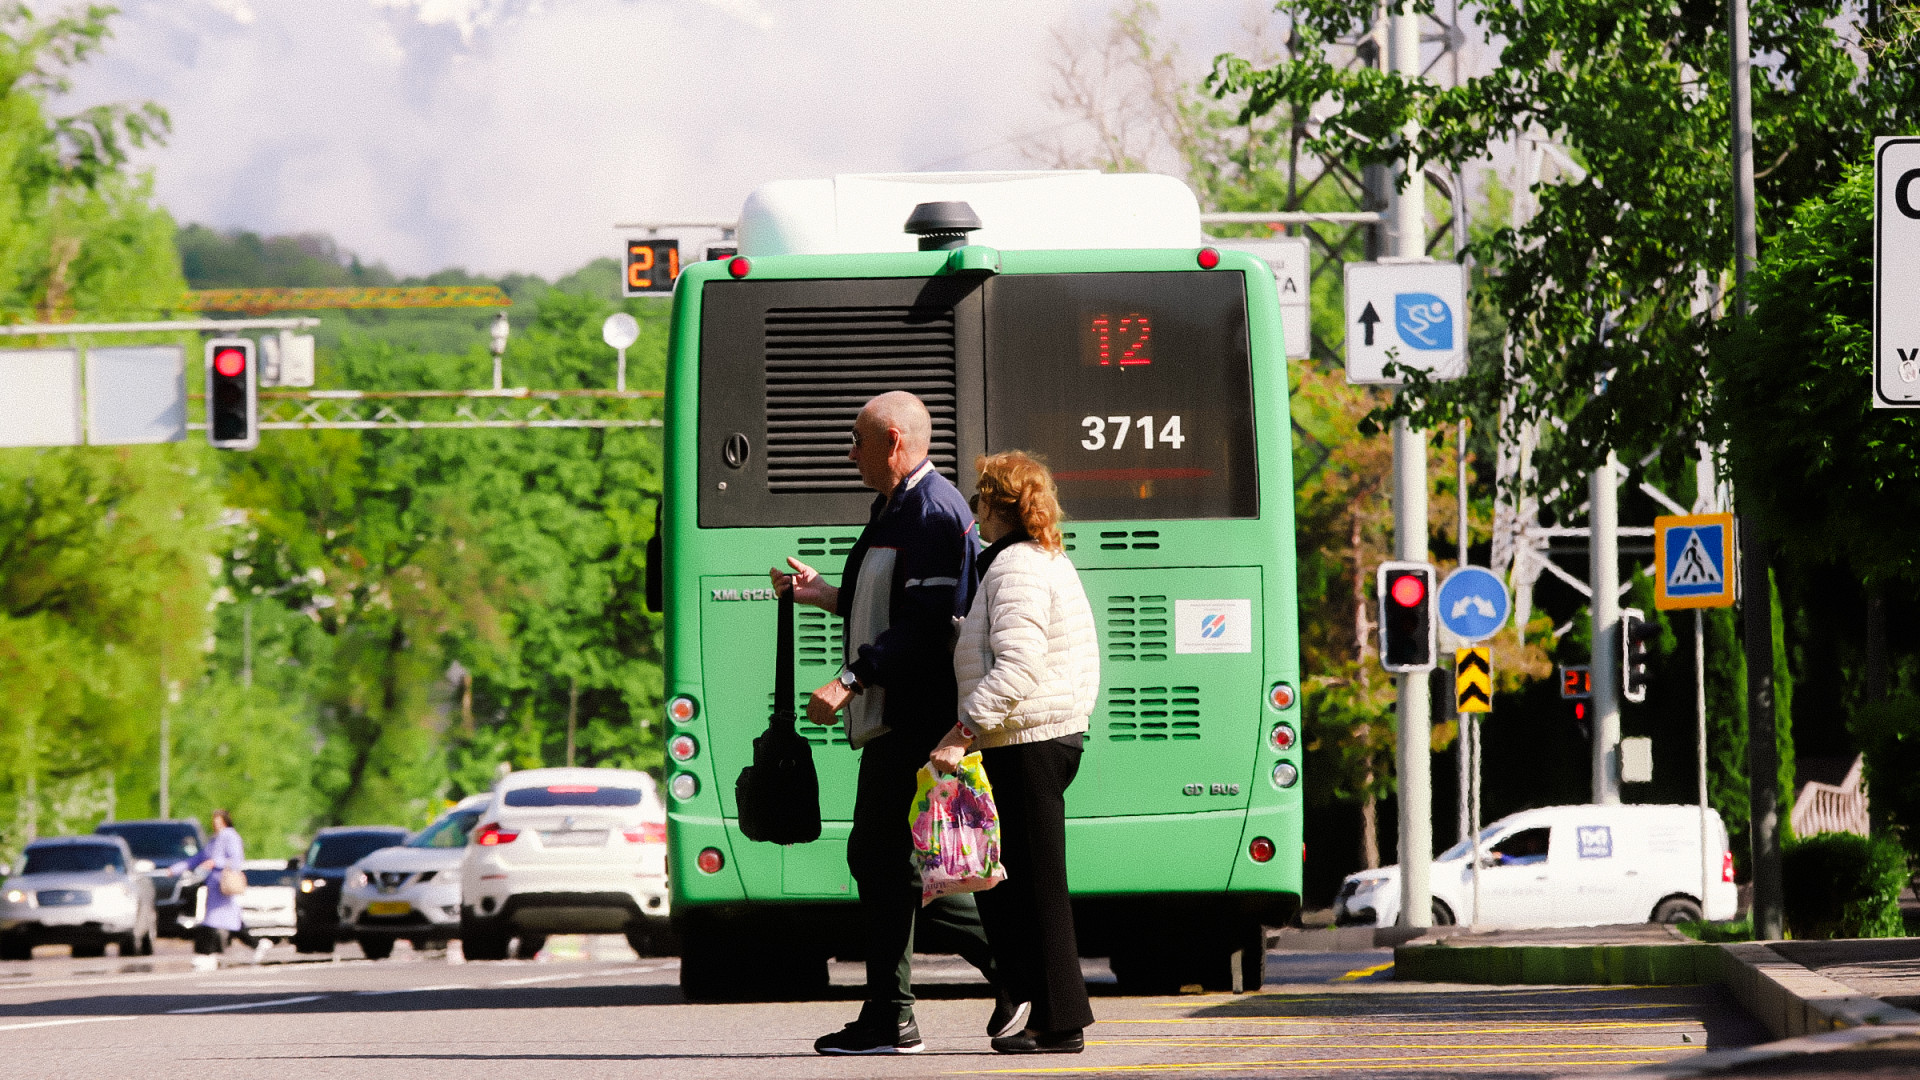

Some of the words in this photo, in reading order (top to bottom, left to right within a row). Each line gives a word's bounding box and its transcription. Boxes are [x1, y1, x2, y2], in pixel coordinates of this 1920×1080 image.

[628, 246, 680, 288] 21
[1092, 314, 1151, 366] 12
[1081, 415, 1186, 451] 3714
[1564, 669, 1592, 696] 21
[1182, 783, 1205, 797] GD
[1210, 783, 1240, 797] BUS
